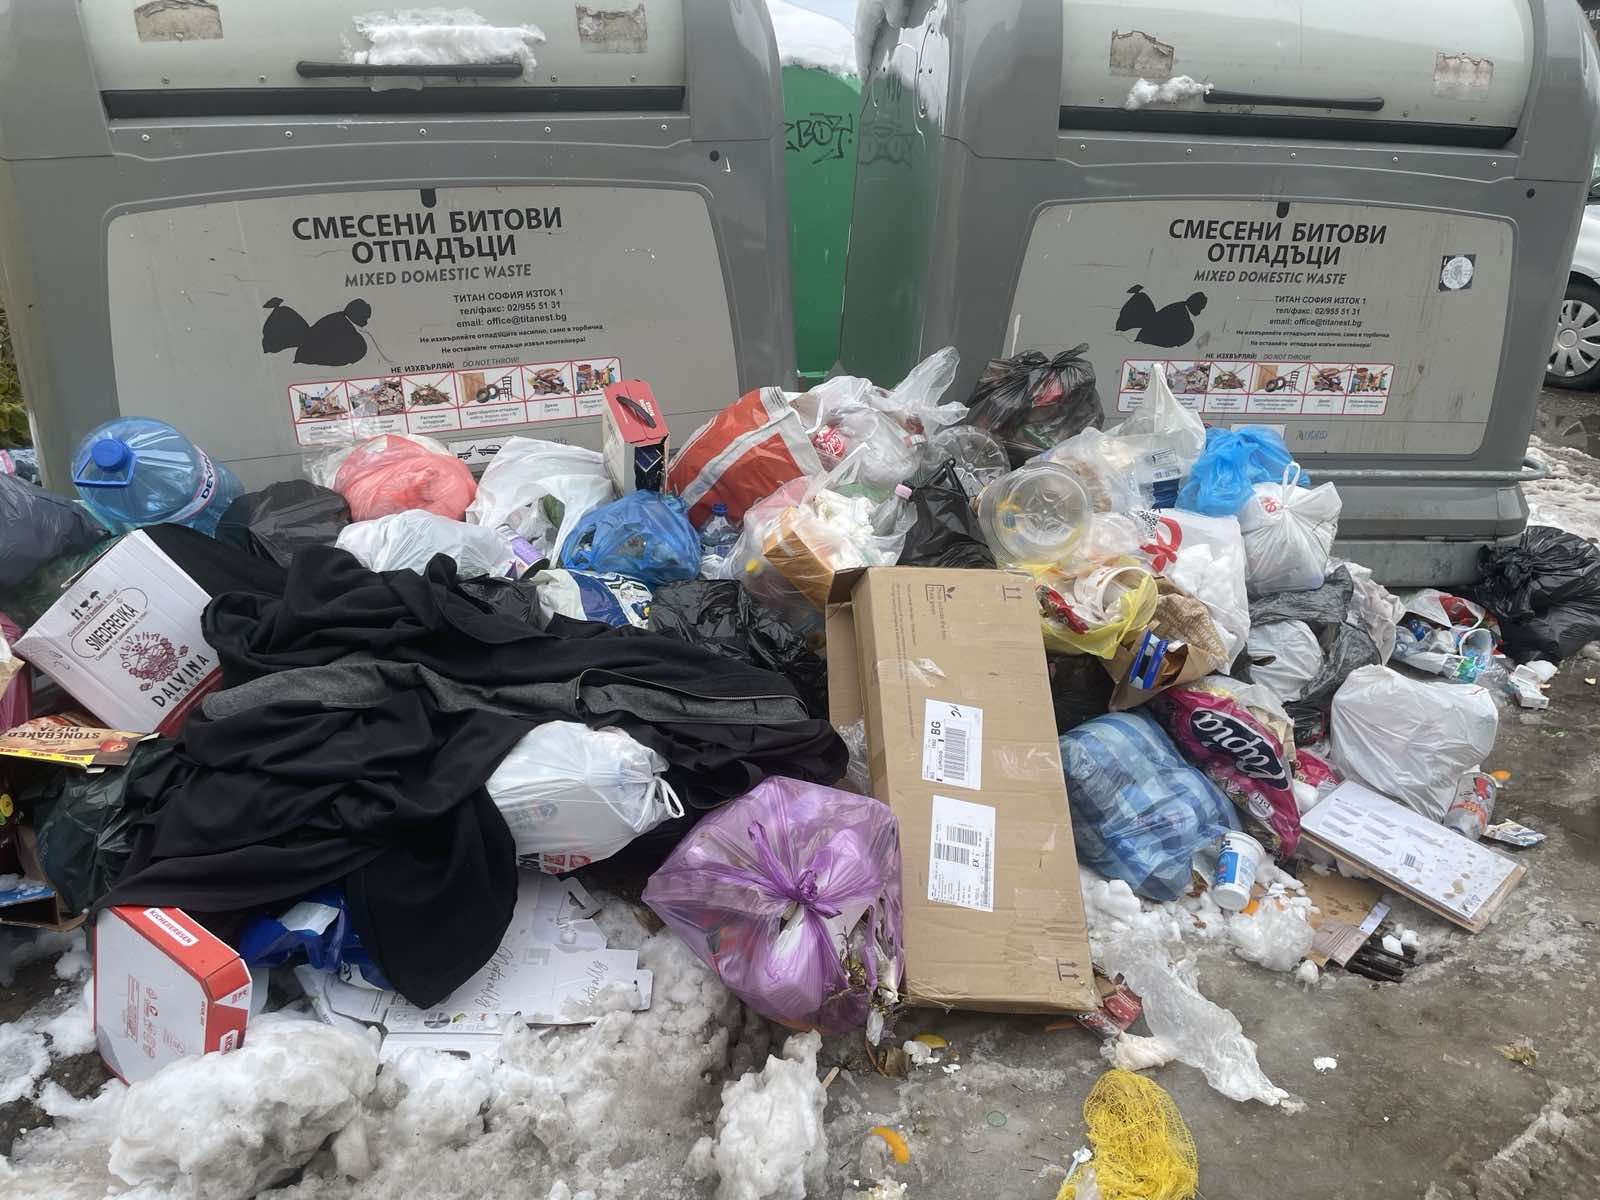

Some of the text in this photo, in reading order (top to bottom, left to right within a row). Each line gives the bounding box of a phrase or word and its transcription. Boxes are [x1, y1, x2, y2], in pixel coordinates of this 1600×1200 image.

[292, 206, 563, 240] СМЕСЕНИ БИТОВИ
[1168, 218, 1387, 245] СМЕСЕНИ БИТОВИ
[351, 234, 517, 264] ОТПАДЪЦИ
[1206, 243, 1341, 269] ОТПАДЪЦИ
[344, 263, 532, 288] MIXED DOMESTIC WASTE
[1193, 270, 1347, 286] MIXED DOMESTIC WASTE
[453, 293, 486, 303] ТИТАН
[488, 291, 524, 301] СОФИЯ
[526, 289, 557, 299] ИЗТОК
[1274, 296, 1300, 304] ТИТАН
[1302, 296, 1332, 304] СОФИЯ
[1334, 297, 1360, 305] ИЗТОК
[460, 300, 561, 316] тел/факс: 02/955 51 31
[1315, 308, 1340, 316] 02/955
[1340, 308, 1350, 316] 51
[1352, 308, 1361, 316] 31
[456, 313, 568, 328] email: office@titanest.bg
[1269, 318, 1363, 328] email: office@titanest.bg
[390, 366, 402, 375] НЕ
[85, 603, 139, 651] SMEDEREVKA
[119, 631, 160, 669] DALVINA
[151, 654, 210, 707] DALVINA
[930, 721, 941, 736] BG
